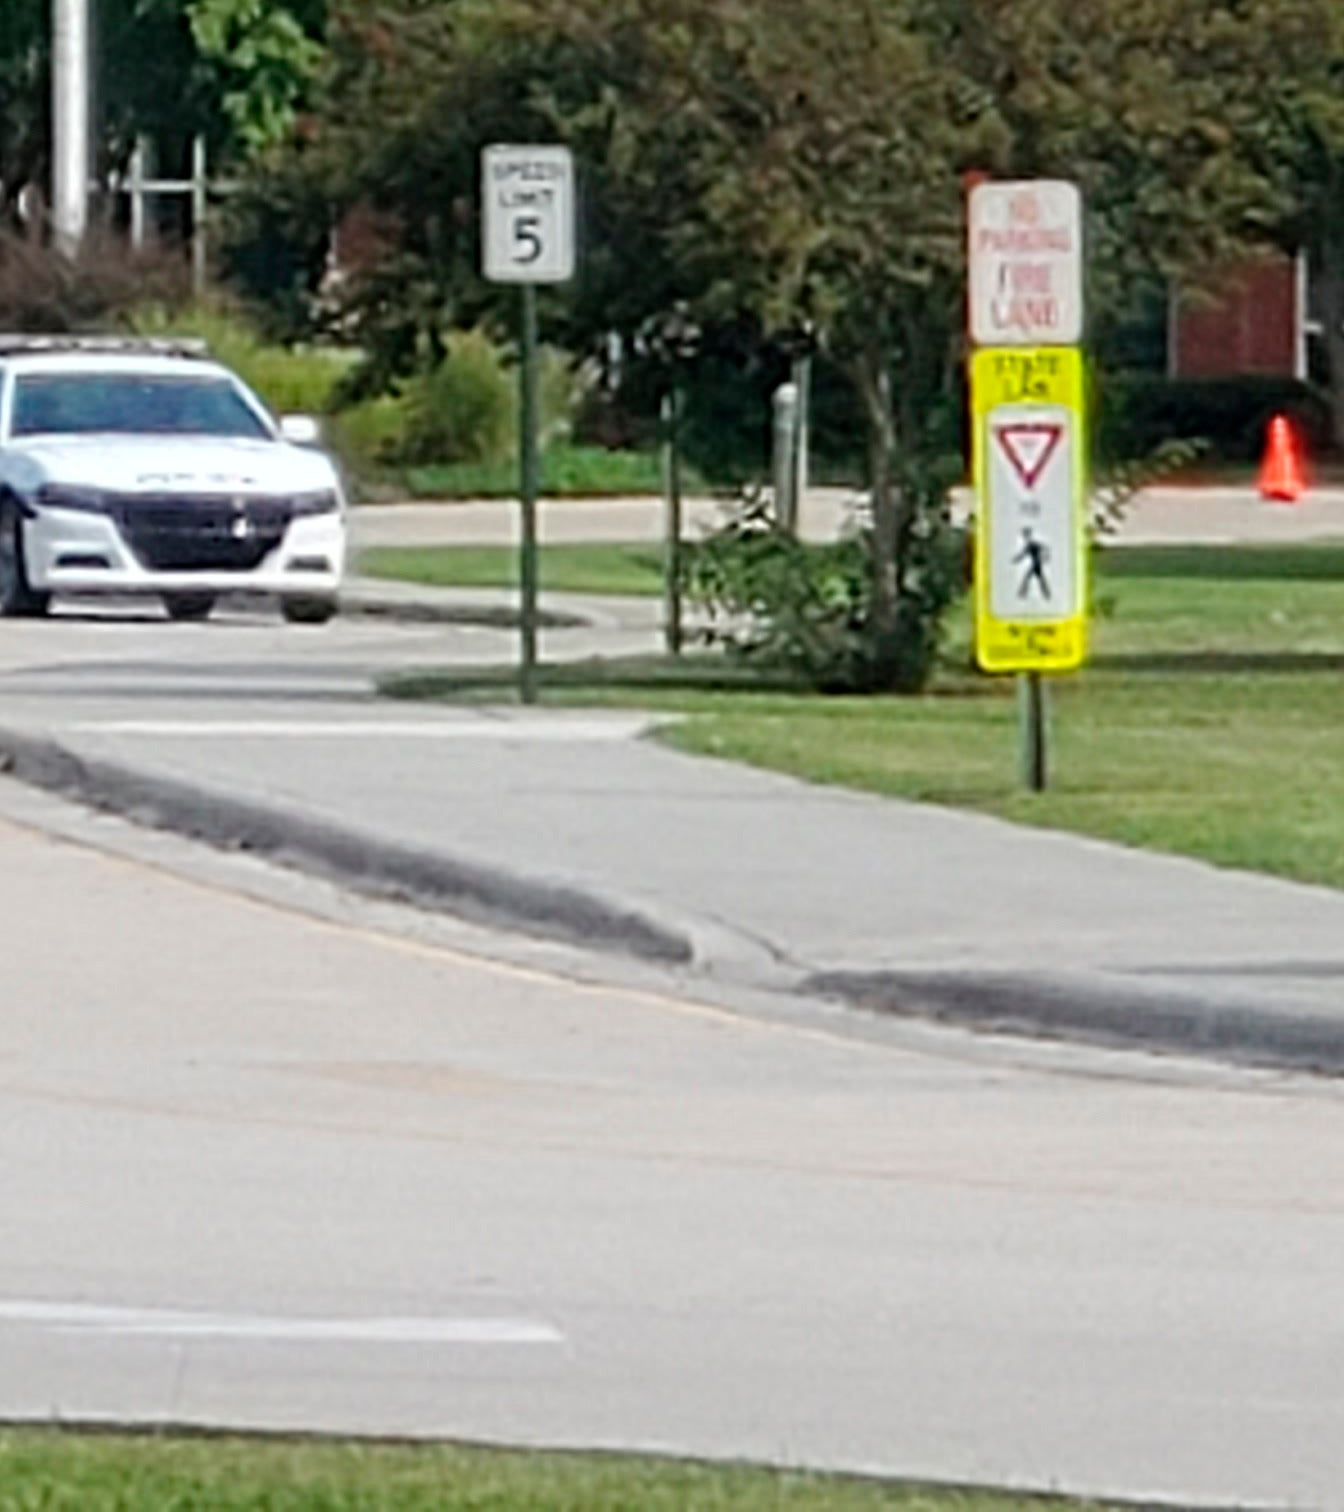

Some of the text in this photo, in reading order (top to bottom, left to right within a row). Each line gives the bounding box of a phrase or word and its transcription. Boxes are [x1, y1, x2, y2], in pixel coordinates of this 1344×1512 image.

[499, 188, 554, 209] LIMIT
[511, 216, 543, 266] 5
[998, 261, 1054, 293] FIRE
[991, 297, 1058, 330] LANE
